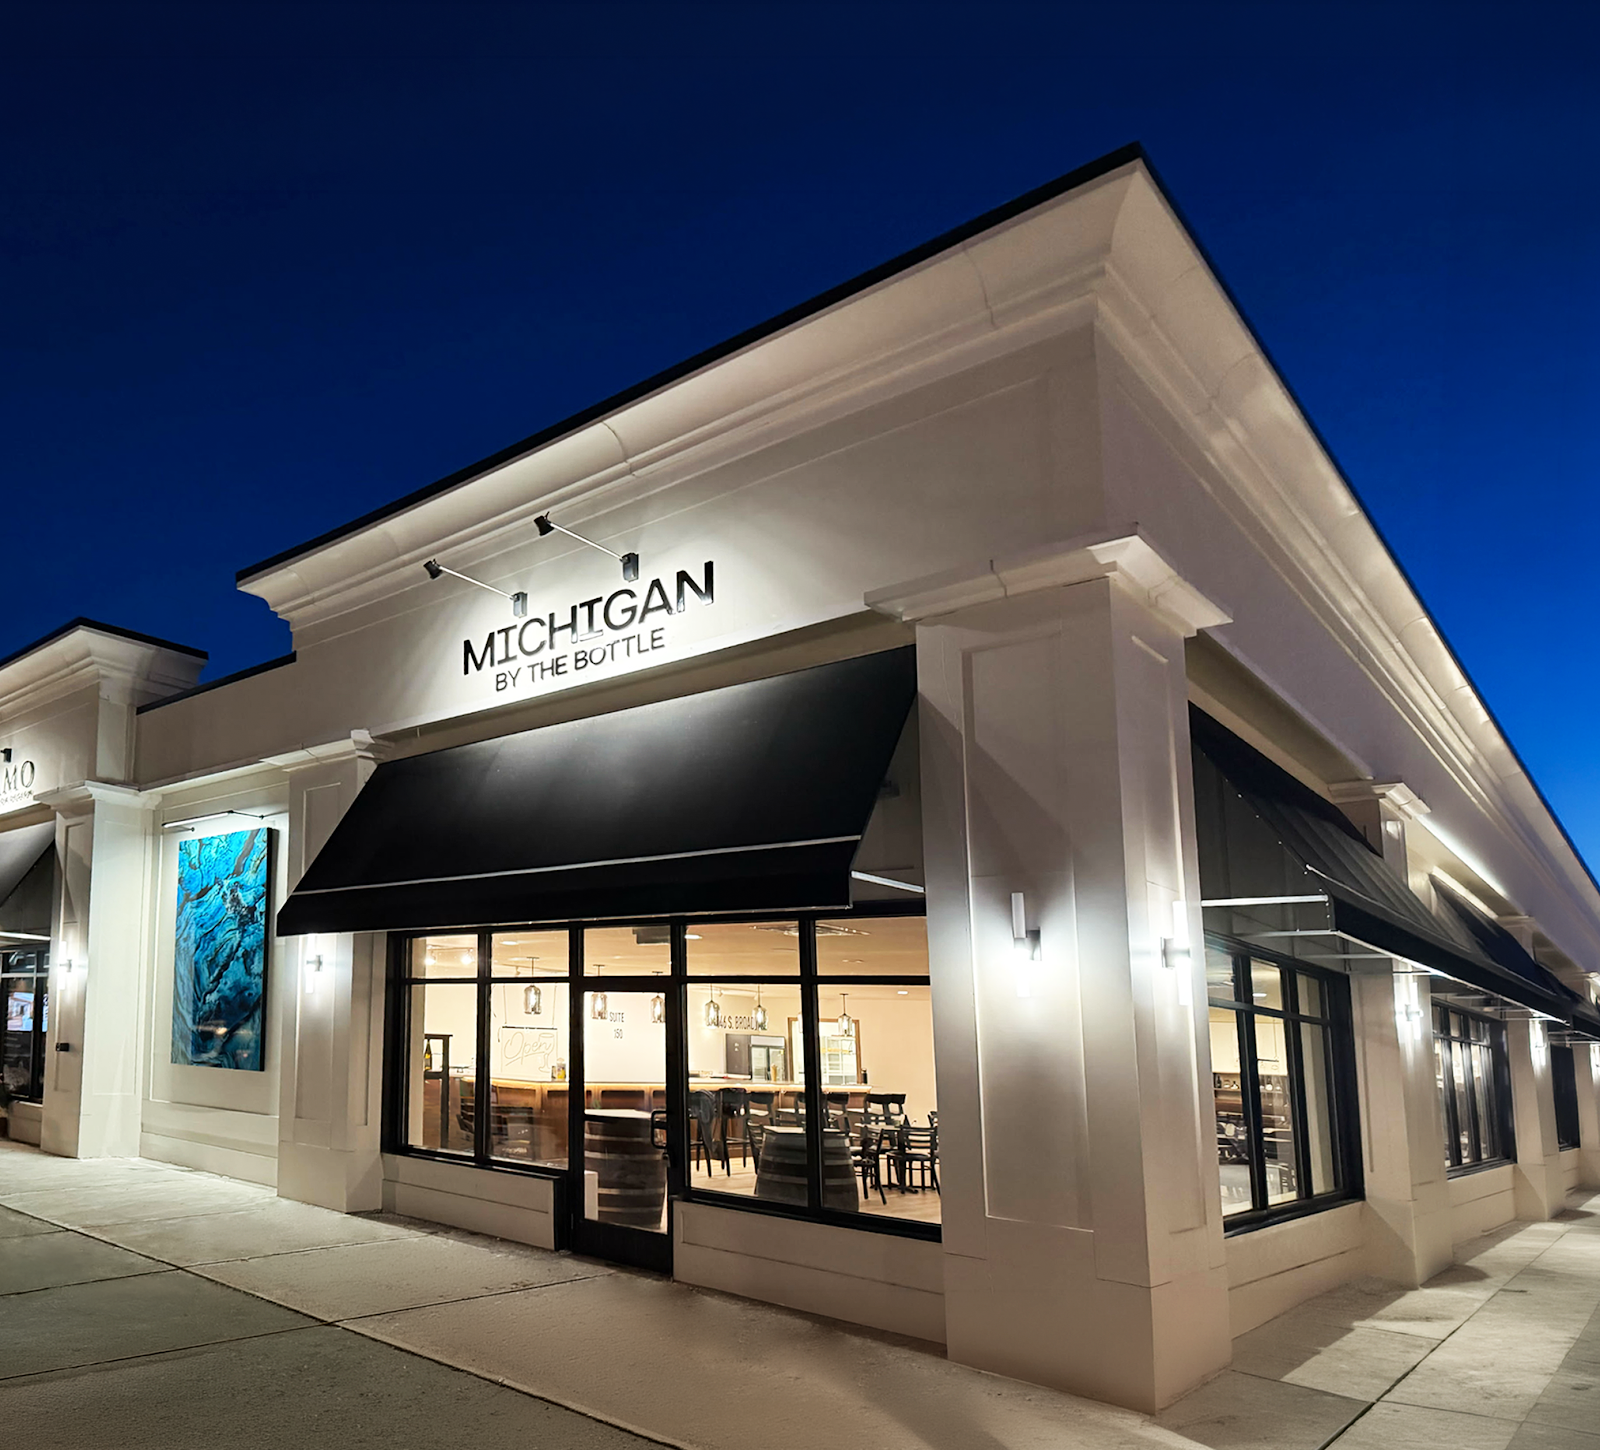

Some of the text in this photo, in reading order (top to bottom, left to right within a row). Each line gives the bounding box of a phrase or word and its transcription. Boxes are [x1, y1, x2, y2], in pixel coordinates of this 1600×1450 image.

[463, 560, 715, 676] MICHIGAN
[495, 627, 666, 692] BY THE BOTTLE
[609, 1011, 625, 1023] SUITE
[503, 1031, 553, 1066] Open
